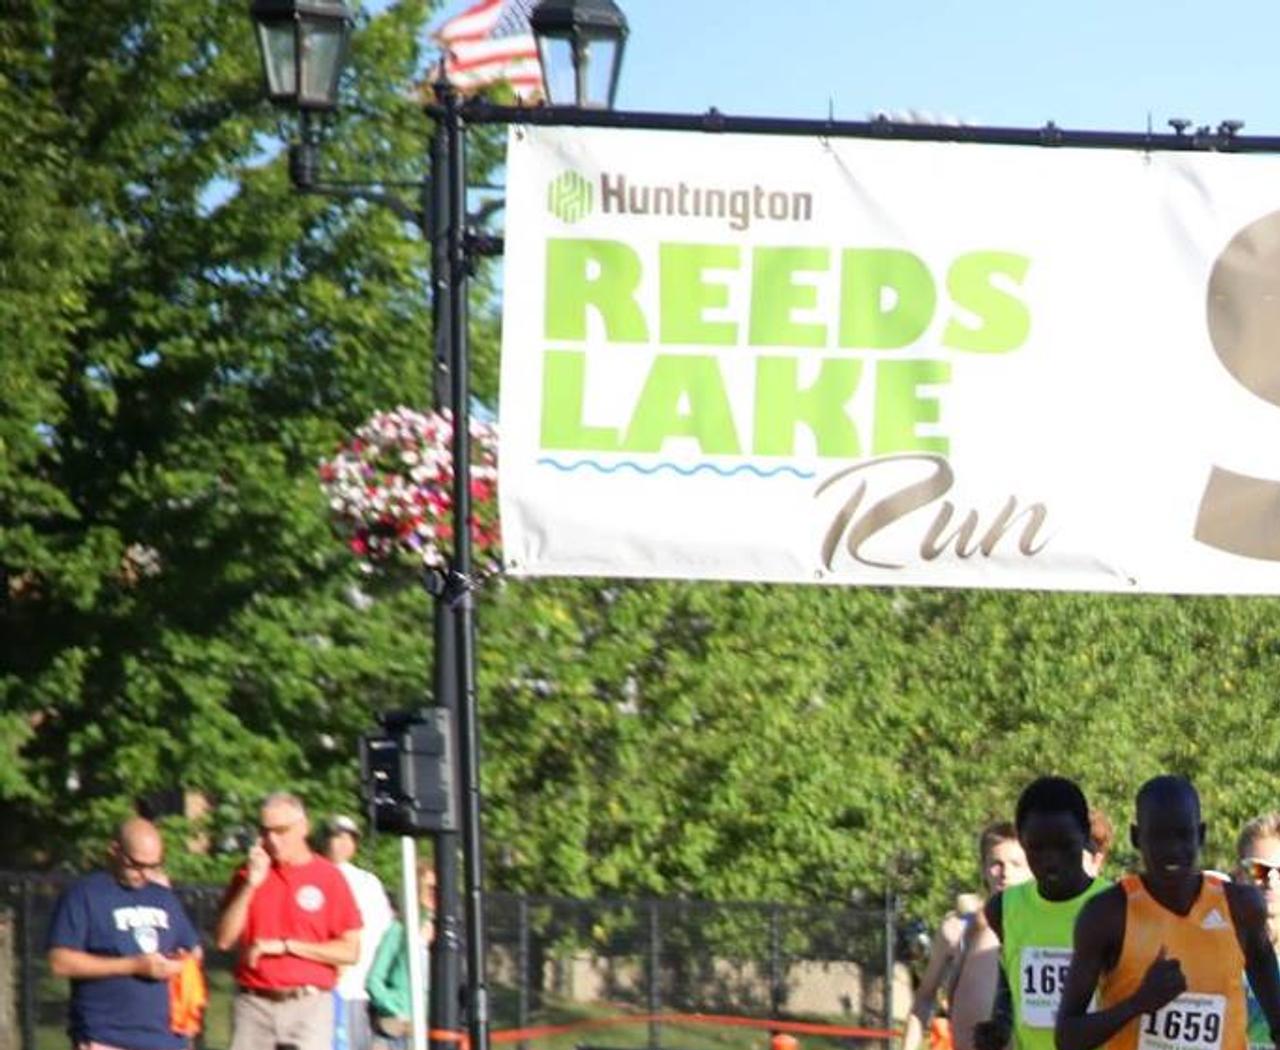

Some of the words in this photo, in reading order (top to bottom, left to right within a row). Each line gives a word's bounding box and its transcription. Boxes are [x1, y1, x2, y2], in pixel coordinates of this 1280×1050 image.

[600, 172, 813, 231] Huntington
[543, 237, 1032, 354] REEDS
[539, 348, 953, 459] LAKE
[814, 453, 1050, 573] Run
[1144, 1010, 1221, 1044] 1659
